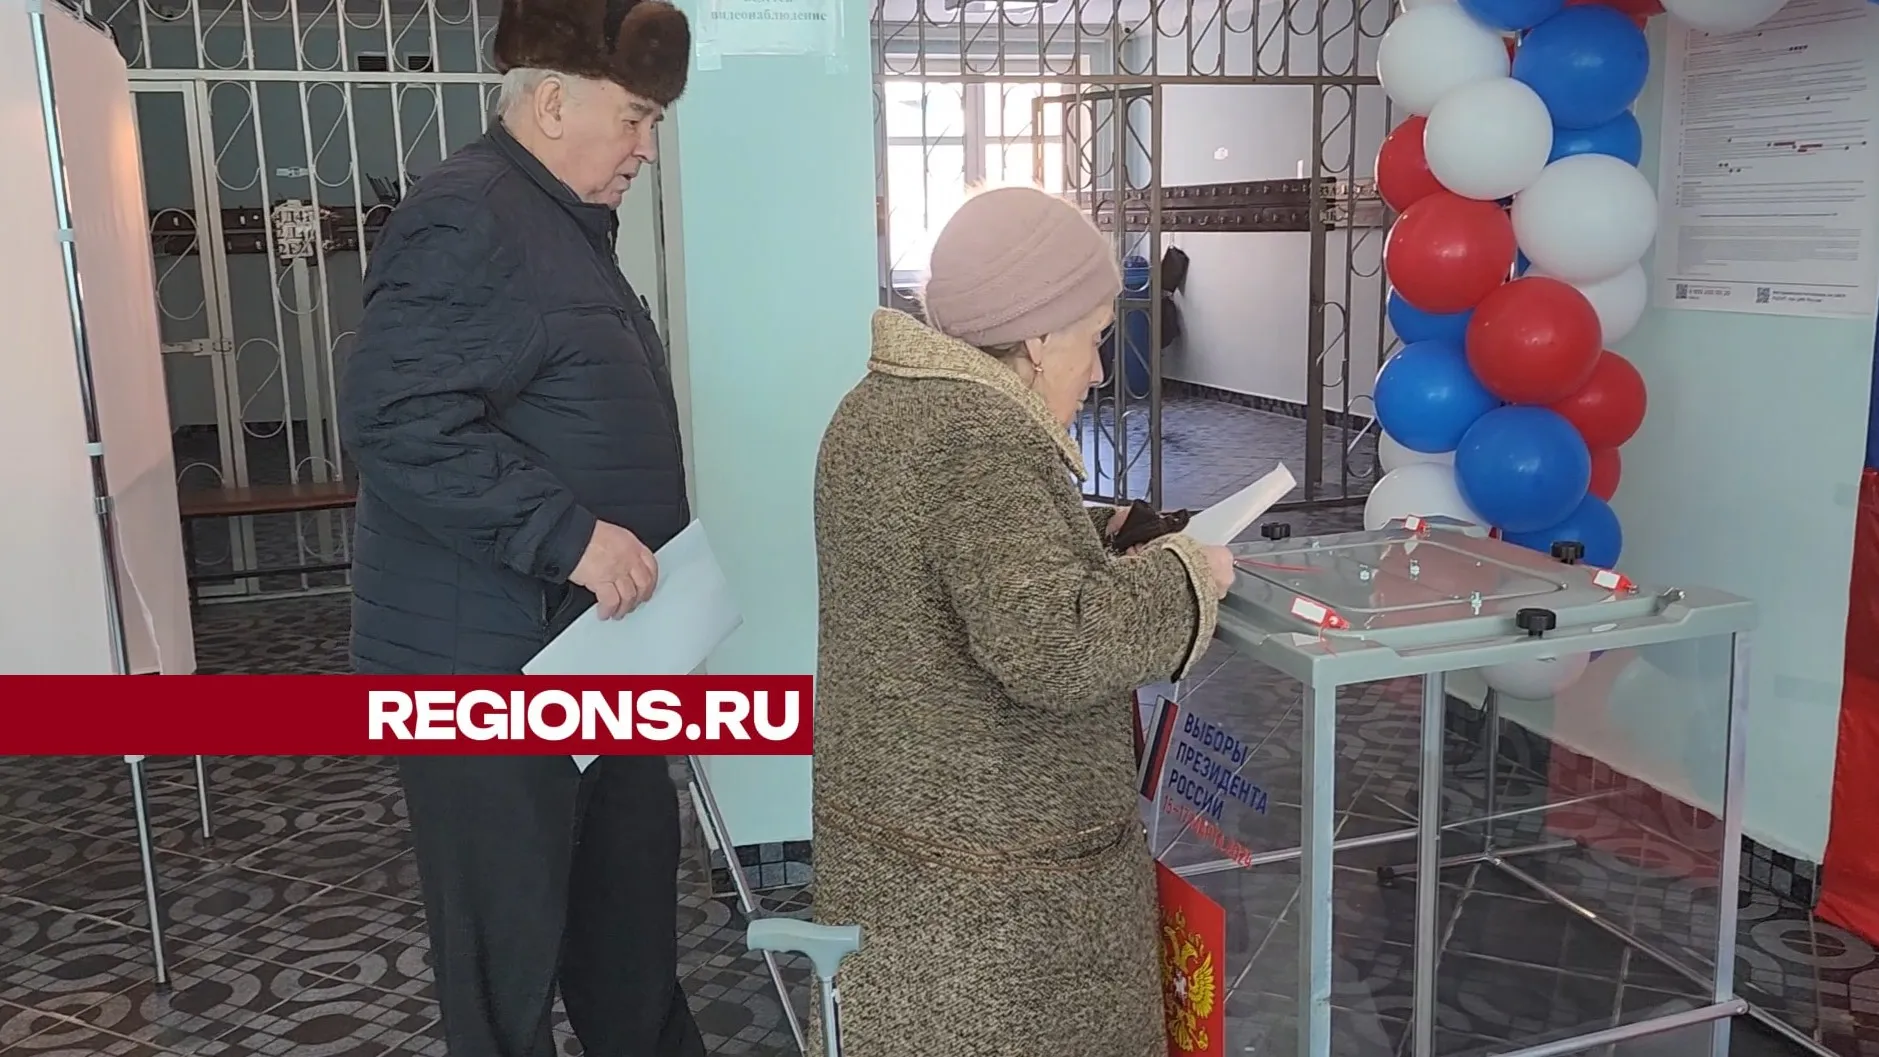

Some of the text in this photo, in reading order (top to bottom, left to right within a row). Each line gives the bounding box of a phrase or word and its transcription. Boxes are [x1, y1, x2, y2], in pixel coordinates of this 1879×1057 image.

[711, 9, 828, 21] видеонаблюдение
[1184, 712, 1248, 765] ВЫБОРЫ
[1168, 768, 1224, 820] РОССИИ
[1176, 742, 1268, 815] ПРЕЗИДЕНТА
